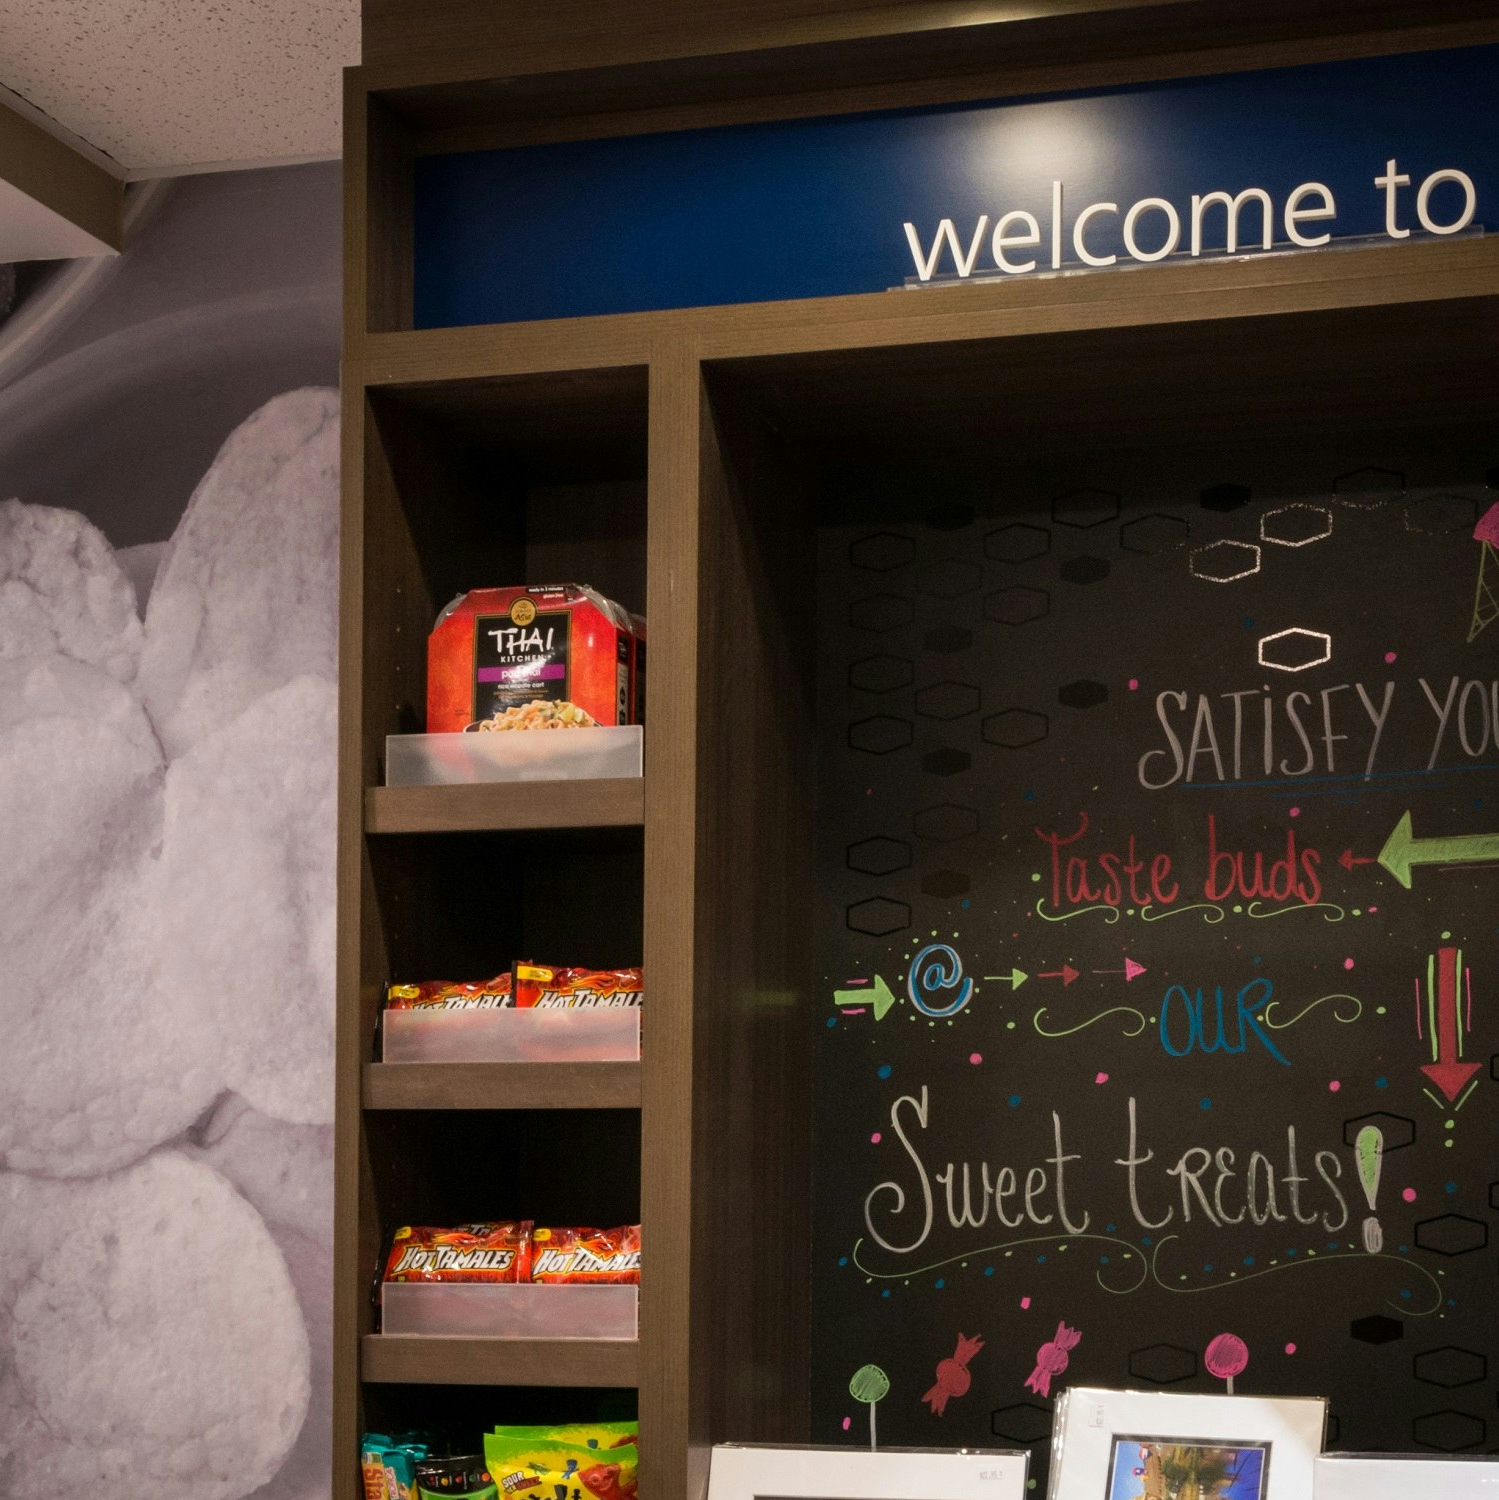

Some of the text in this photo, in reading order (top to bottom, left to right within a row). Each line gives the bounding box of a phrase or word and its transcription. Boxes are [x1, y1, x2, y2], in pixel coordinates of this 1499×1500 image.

[902, 180, 1337, 282] welcome
[1374, 158, 1478, 239] to
[488, 628, 554, 655] THAI
[1138, 681, 1396, 788] SATISFY
[1037, 812, 1323, 909] Taste buds
[865, 1086, 1088, 1252] Sweet
[396, 1245, 516, 1271] HOT TAMALES
